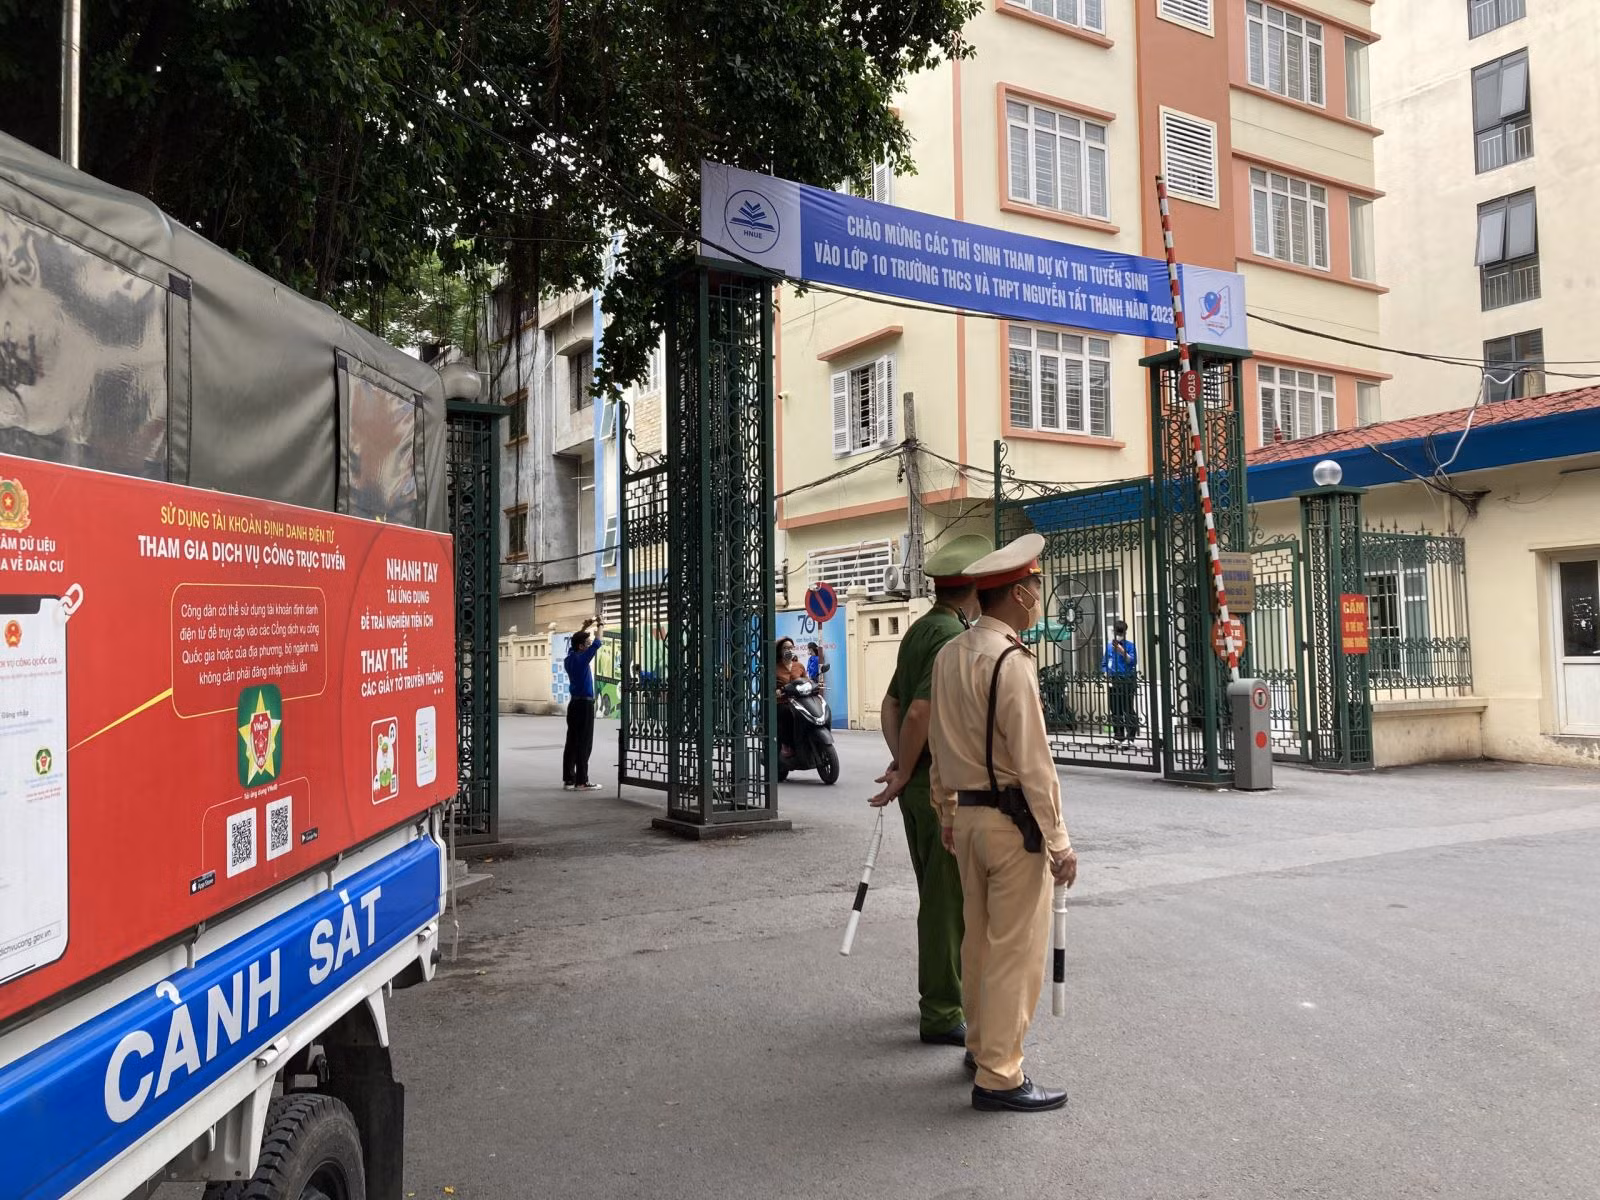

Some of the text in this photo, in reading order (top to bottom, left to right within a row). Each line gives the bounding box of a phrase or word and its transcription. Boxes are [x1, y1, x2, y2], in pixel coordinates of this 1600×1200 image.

[743, 230, 763, 240] HNUE
[847, 216, 1149, 292] CHÀO MỪNG CÁC THÍ SINH THAM DỰ KỲ THI TUYỂN SINH
[814, 240, 1174, 324] VÀO LỚP 10 TRƯỜNG THCS VÀ THPT NGUYỄN TẤT THÀNH NĂM 2023
[1188, 374, 1196, 398] STOP
[161, 502, 177, 525] SỬ
[178, 508, 210, 532] DỤNG
[212, 509, 226, 531] TÀI
[264, 520, 284, 540] ĐỊNH
[286, 524, 308, 541] DANH
[309, 525, 325, 546] ĐIỆN
[326, 526, 335, 544] TỬ
[0, 533, 17, 550] ÂM
[37, 536, 56, 555] LIỆU
[138, 535, 346, 572] THAM GIA DỊCH VỤ CÔNG TRỰC TUYẾN
[10, 551, 23, 571] VỀ
[26, 556, 47, 572] DÂN
[49, 560, 64, 573] CƯ
[386, 558, 438, 583] NHANH TAY
[387, 585, 430, 608] TẢI ỨNG DỤNG
[181, 604, 202, 620] Công
[203, 604, 216, 617] dân
[218, 604, 227, 616] có
[228, 601, 238, 616] thể
[240, 602, 250, 616] sử
[250, 604, 266, 618] dụng
[276, 603, 292, 615] khoản
[294, 604, 304, 616] định
[306, 604, 318, 615] danh
[361, 606, 434, 632] ĐỂ TRẢI NGHIỆM TIỆN ÍCH
[180, 628, 196, 643] điện
[198, 626, 206, 640] tử
[208, 624, 218, 640] để
[218, 626, 232, 641] truy
[233, 625, 245, 641] cập
[246, 624, 258, 636] vào
[259, 624, 270, 636] các
[288, 624, 298, 636] dịch
[300, 625, 306, 635] vụ
[307, 622, 320, 636] công
[798, 615, 816, 634] 70
[182, 641, 318, 665] Quốc gia hoặc của địa phương, bộ ngành mà
[360, 634, 408, 674] THAY THẾ
[200, 672, 220, 686] không
[222, 666, 235, 682] cần
[236, 666, 250, 683] phải
[252, 666, 268, 680] đăng
[268, 664, 282, 677] nhập
[361, 664, 444, 697] CÁC GIẤY TỜ TRUYỀN THỐNG
[254, 721, 268, 732] VNeID
[104, 948, 281, 1124] CẢNH
